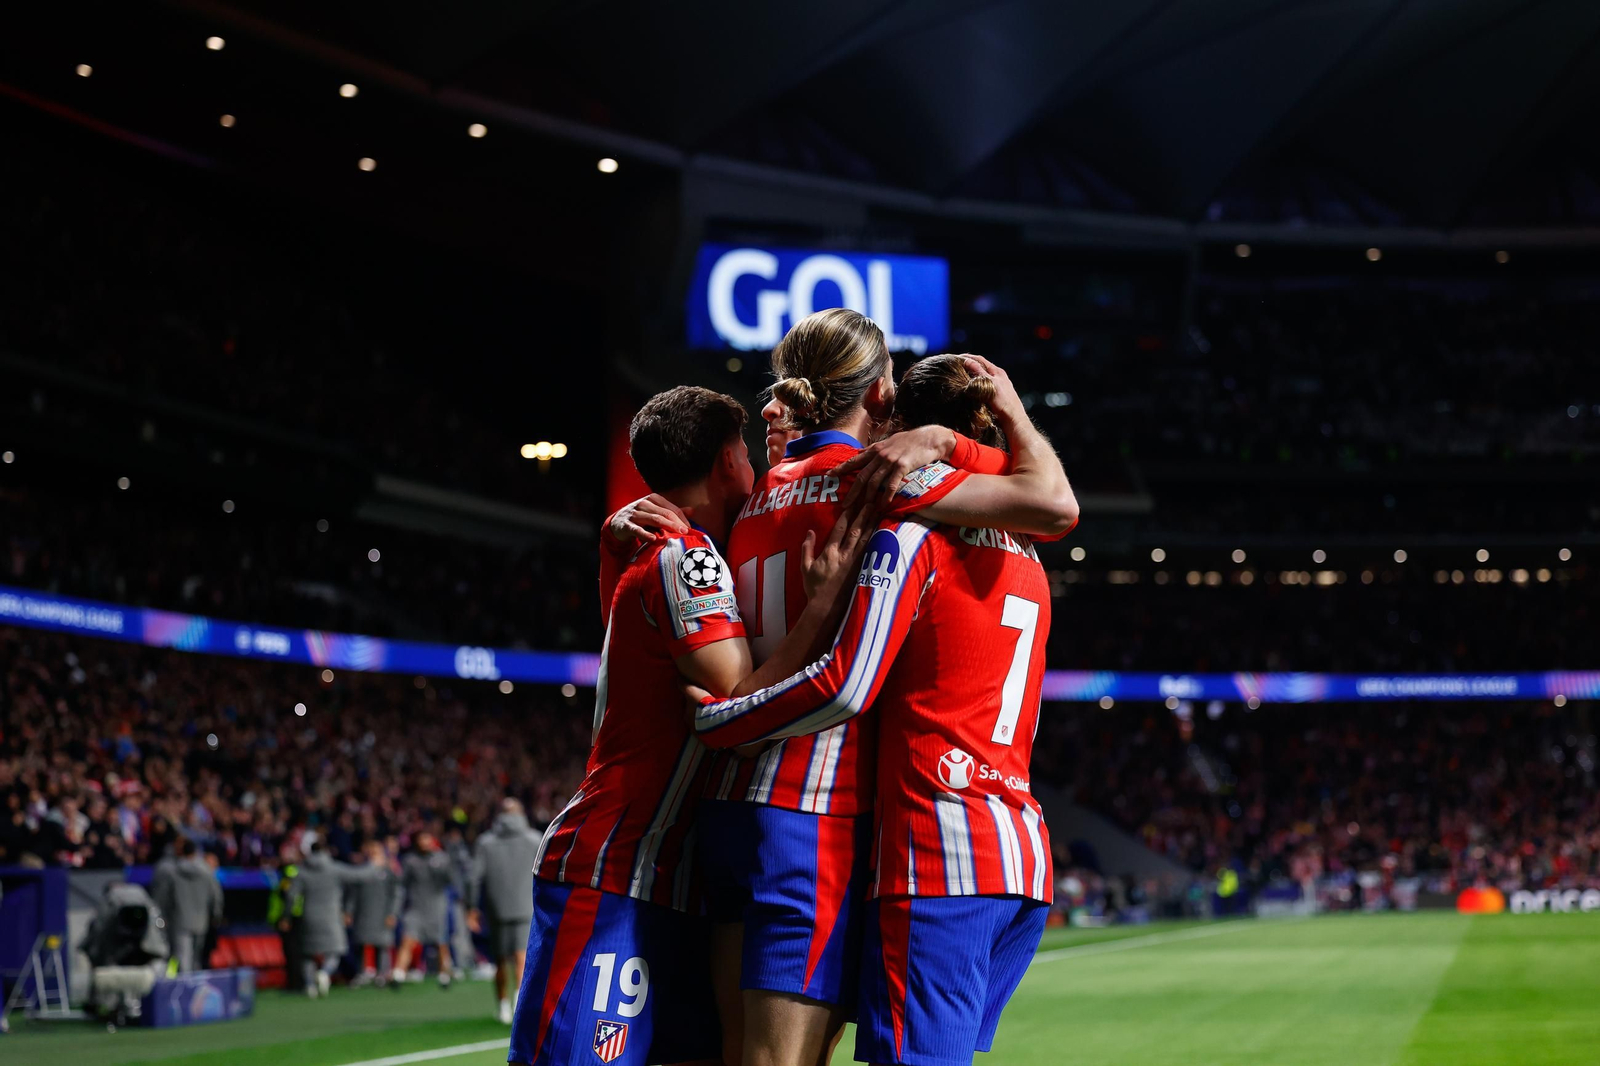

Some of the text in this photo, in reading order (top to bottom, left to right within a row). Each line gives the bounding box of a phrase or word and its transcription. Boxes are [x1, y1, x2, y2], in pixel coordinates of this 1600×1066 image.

[707, 248, 928, 354] GOL
[680, 597, 733, 614] FOUNDATION
[454, 645, 500, 681] GOL
[990, 592, 1040, 747] 7
[592, 952, 650, 1018] 19
